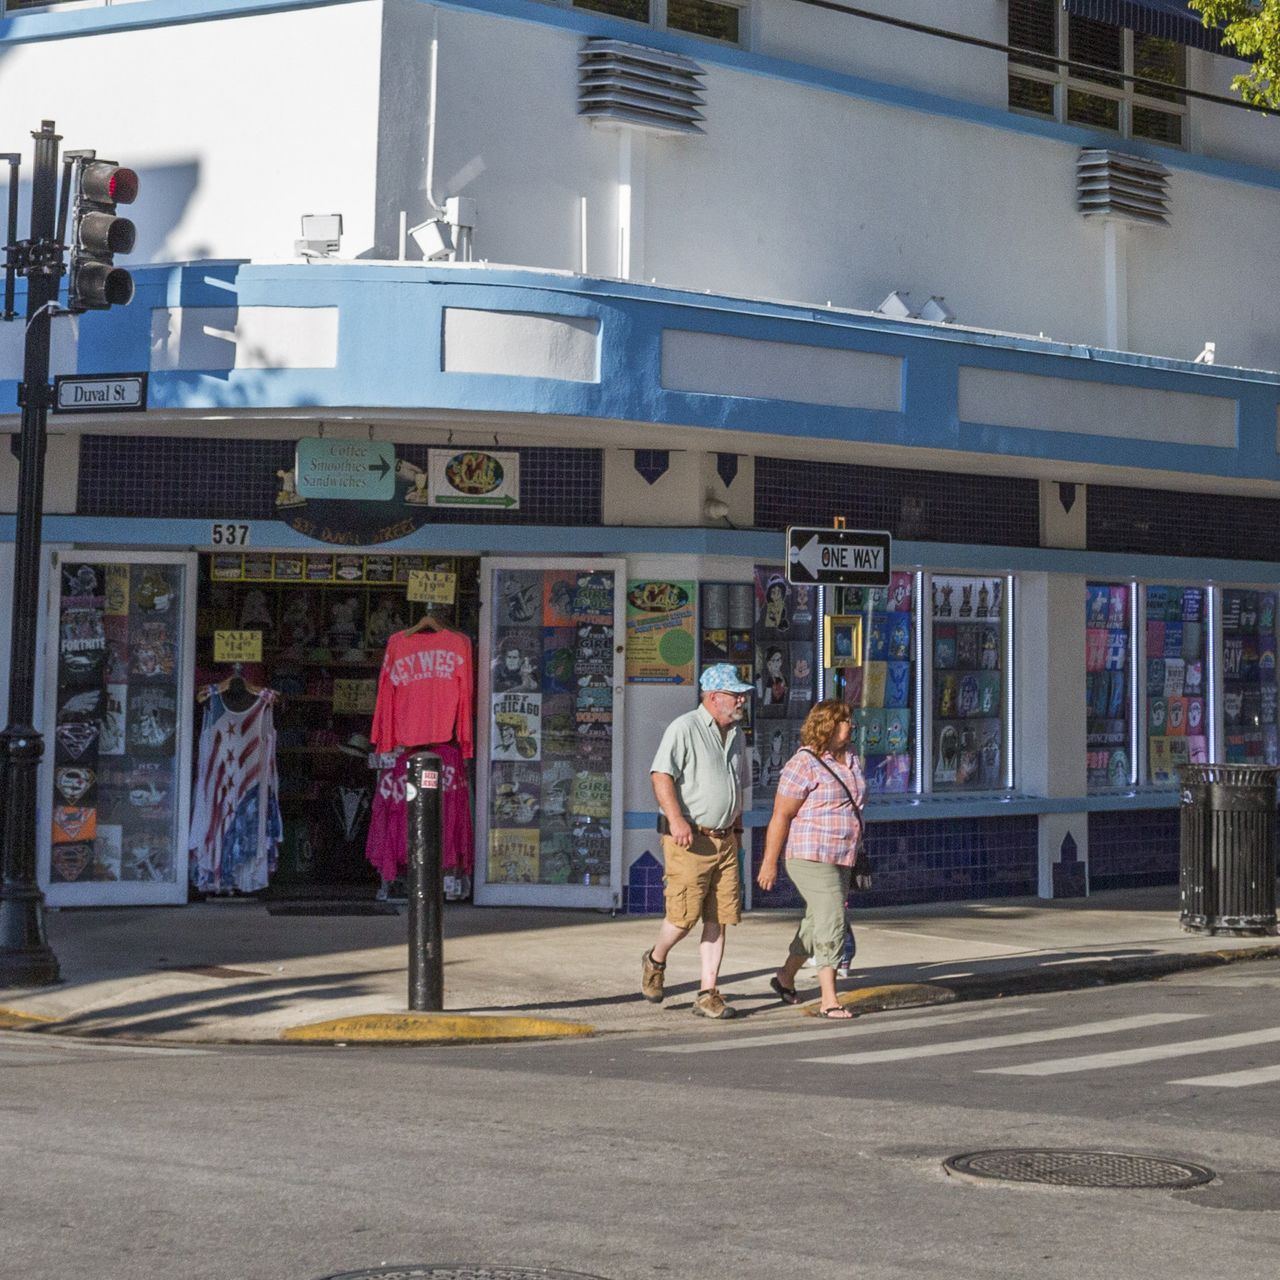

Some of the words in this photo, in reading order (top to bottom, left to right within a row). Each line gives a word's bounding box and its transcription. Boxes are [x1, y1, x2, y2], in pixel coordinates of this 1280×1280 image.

[73, 384, 110, 403] Duval
[113, 383, 126, 401] St
[329, 445, 368, 457] Coffee
[309, 458, 367, 472] Smoothies
[303, 474, 367, 487] Sandwiches
[213, 524, 250, 545] 537
[822, 546, 848, 568] ONE
[853, 548, 880, 569] WAY
[411, 572, 454, 583] SALE
[217, 632, 260, 641] SALE
[580, 639, 610, 648] GIRL
[62, 638, 106, 652] FORTNITE
[389, 654, 417, 687] KEY
[493, 701, 539, 716] CHICAGO
[578, 781, 611, 791] GIRL
[492, 842, 536, 858] SEATTLE
[575, 839, 609, 848] GIRL
